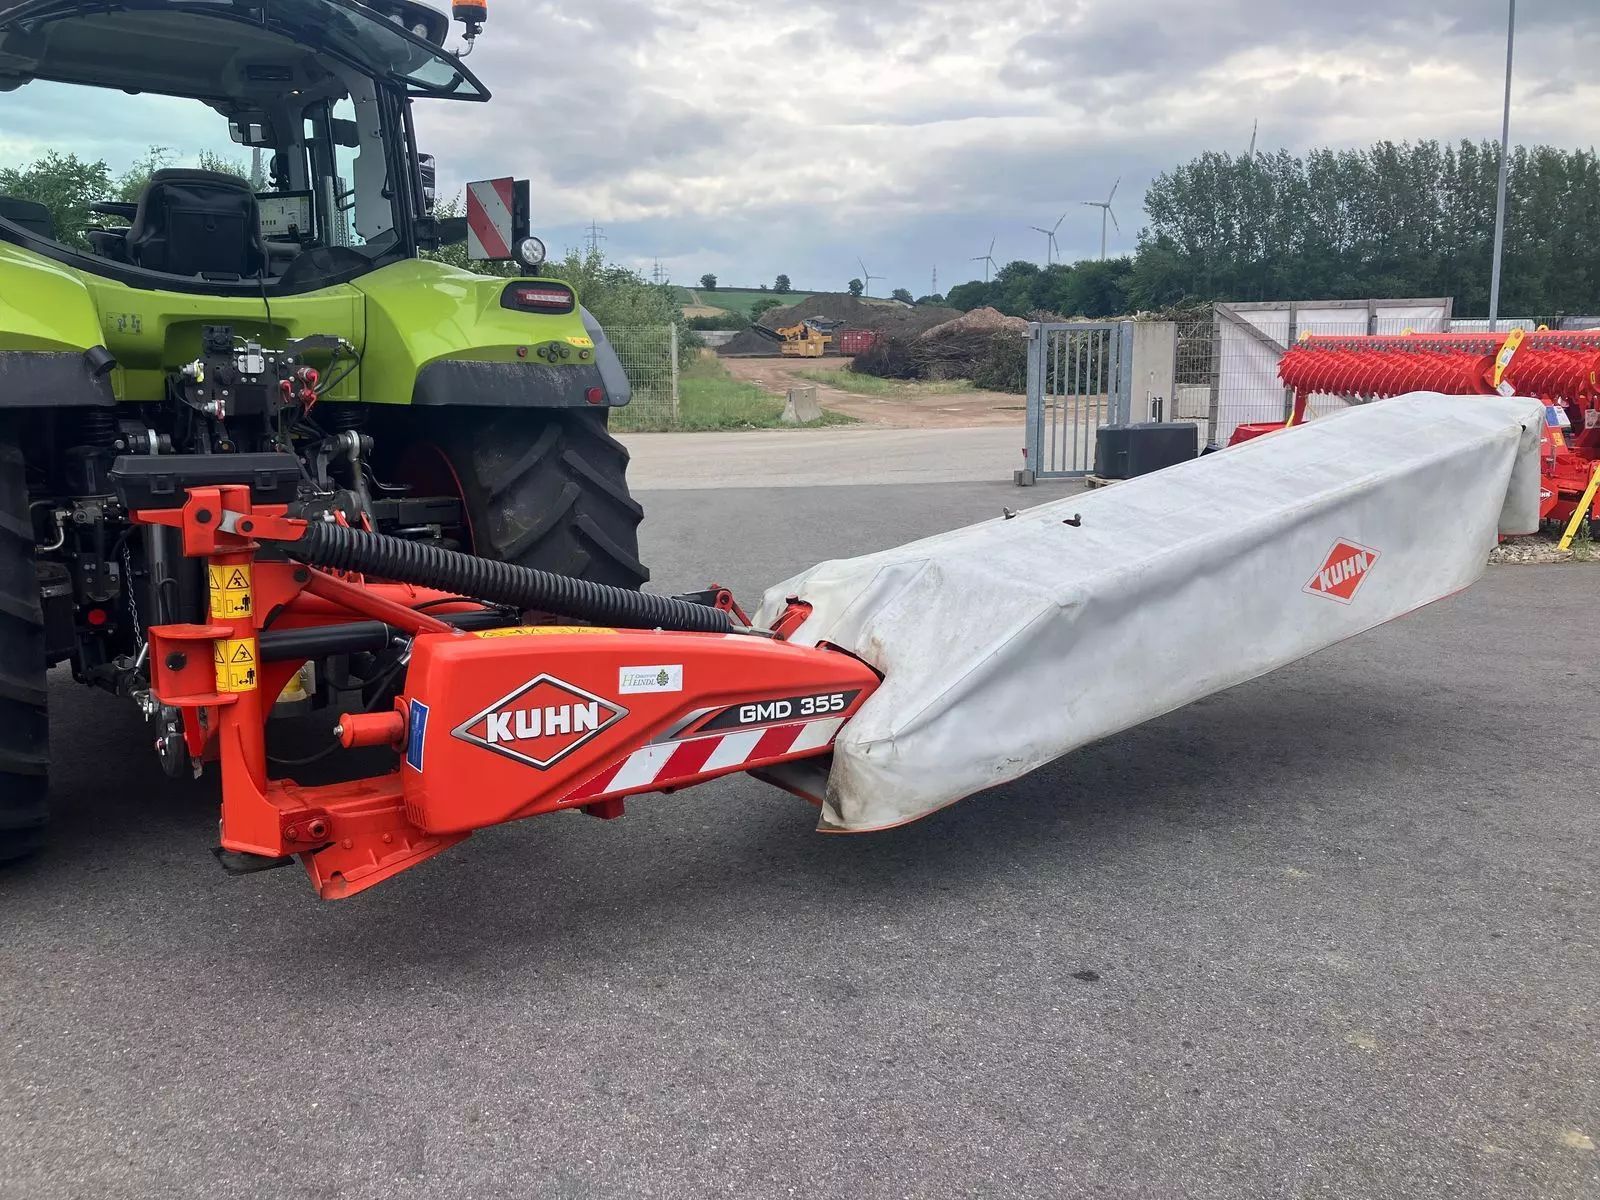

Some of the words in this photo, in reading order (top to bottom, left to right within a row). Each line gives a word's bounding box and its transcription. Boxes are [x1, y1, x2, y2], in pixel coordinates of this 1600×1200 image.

[1319, 550, 1368, 592] KUHN
[486, 701, 599, 743] KUHN
[740, 701, 792, 723] GMD
[800, 694, 845, 715] 355
